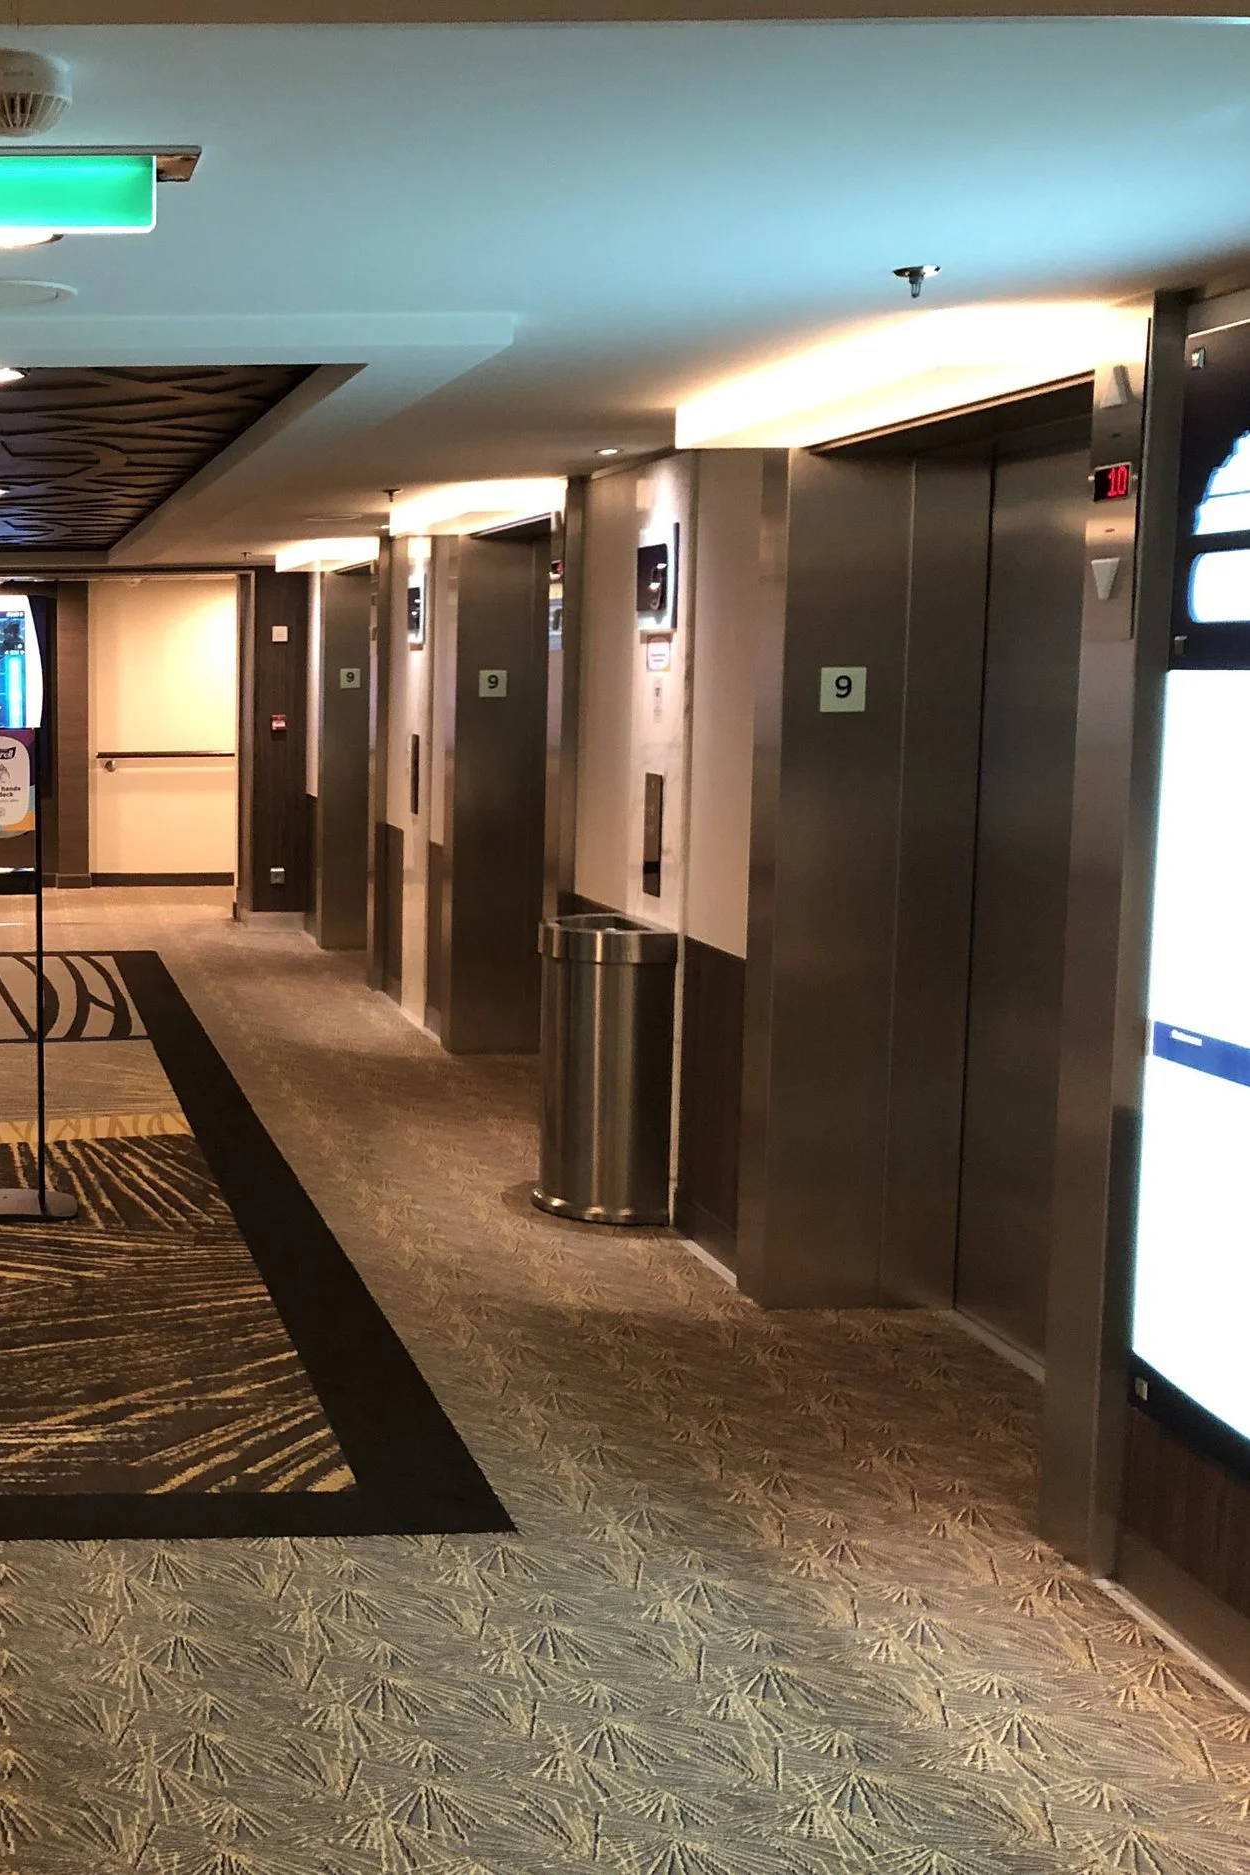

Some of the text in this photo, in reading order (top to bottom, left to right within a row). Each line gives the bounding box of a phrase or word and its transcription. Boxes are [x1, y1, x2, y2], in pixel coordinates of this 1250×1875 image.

[1107, 465, 1128, 497] 10
[345, 671, 355, 683] 9
[487, 674, 499, 689] 9
[835, 675, 853, 699] 9
